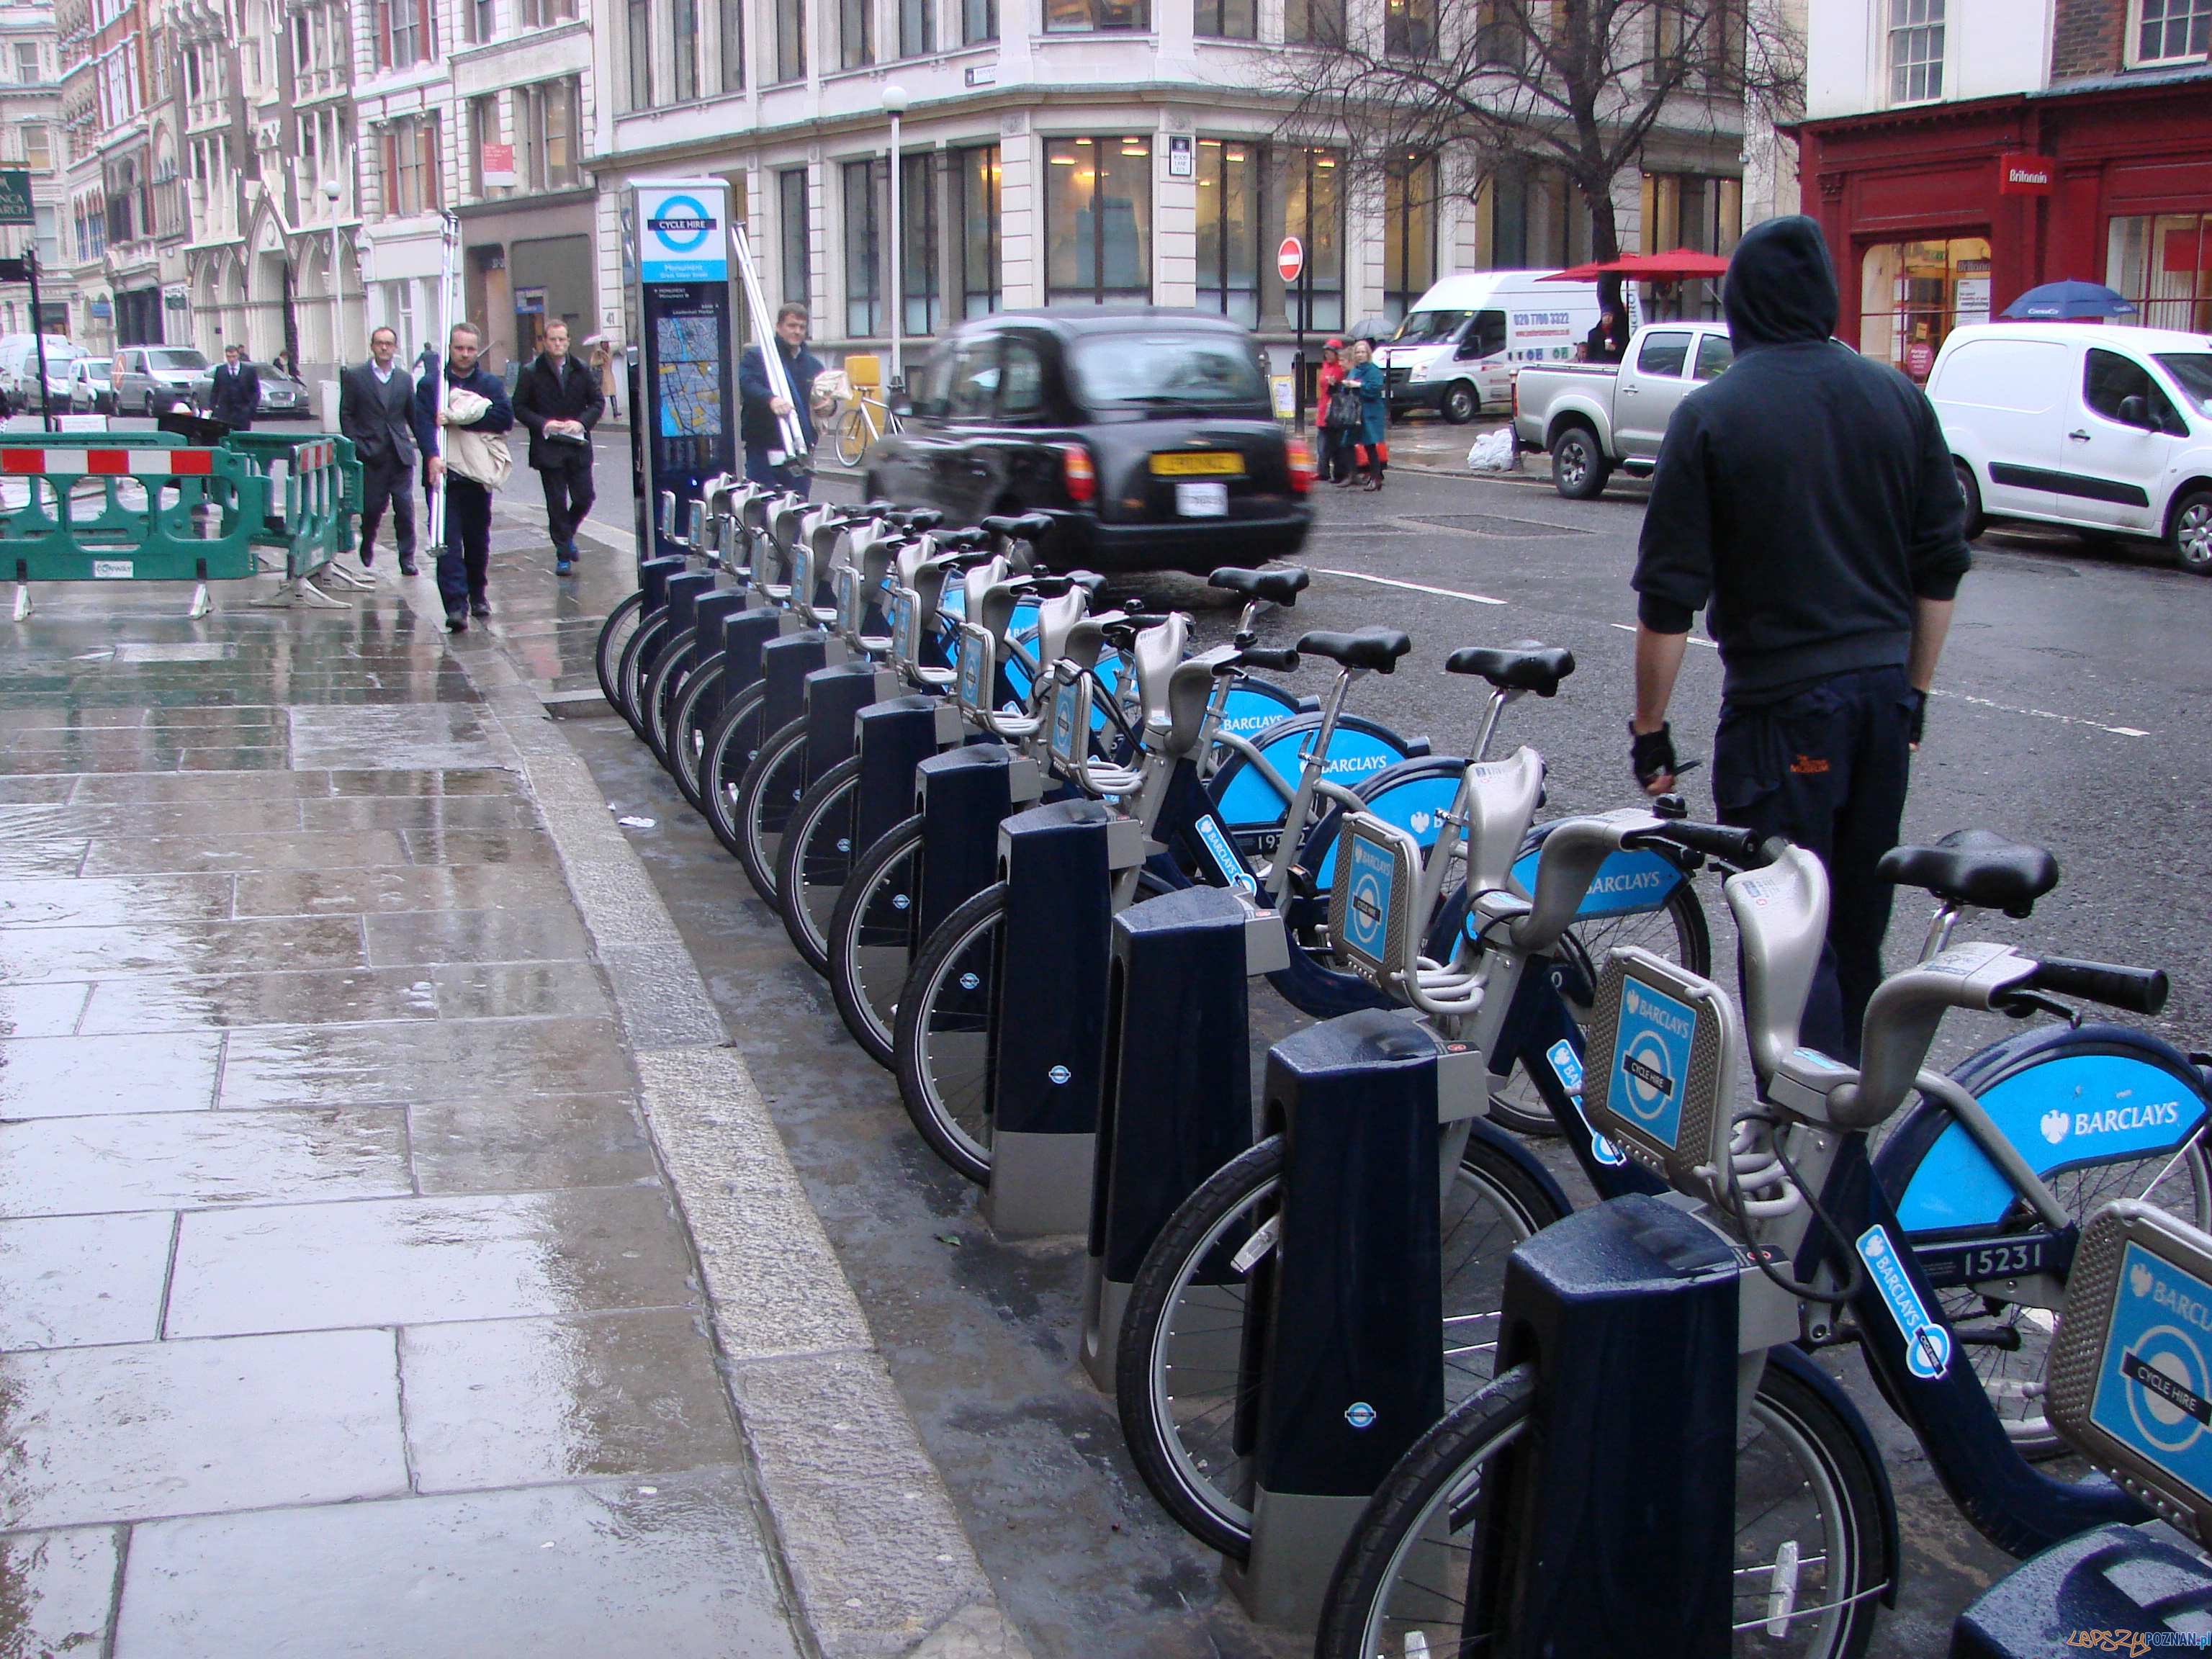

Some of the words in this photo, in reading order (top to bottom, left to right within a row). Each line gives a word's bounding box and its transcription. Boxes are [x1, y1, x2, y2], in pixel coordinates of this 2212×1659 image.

[2009, 168, 2047, 184] Britannia
[659, 220, 685, 229] CYCLE
[687, 220, 706, 229] HIRE
[1224, 715, 1283, 732] BARCLAYS
[1208, 832, 1237, 876] BARCLAYS
[1362, 851, 1391, 877] BARCLAYS
[1638, 999, 1690, 1040] BARCLAYS
[1631, 1061, 1650, 1082] CYCLE
[1649, 1073, 1665, 1089] HIRE
[2074, 1101, 2179, 1136] BARCLAYS
[1964, 1243, 2041, 1276] 15231
[1875, 1255, 1922, 1327] BARCLAYS
[1920, 1334, 1933, 1355] CYCLE
[2137, 1366, 2170, 1392] CYCLE
[2170, 1386, 2197, 1413] HIRE
